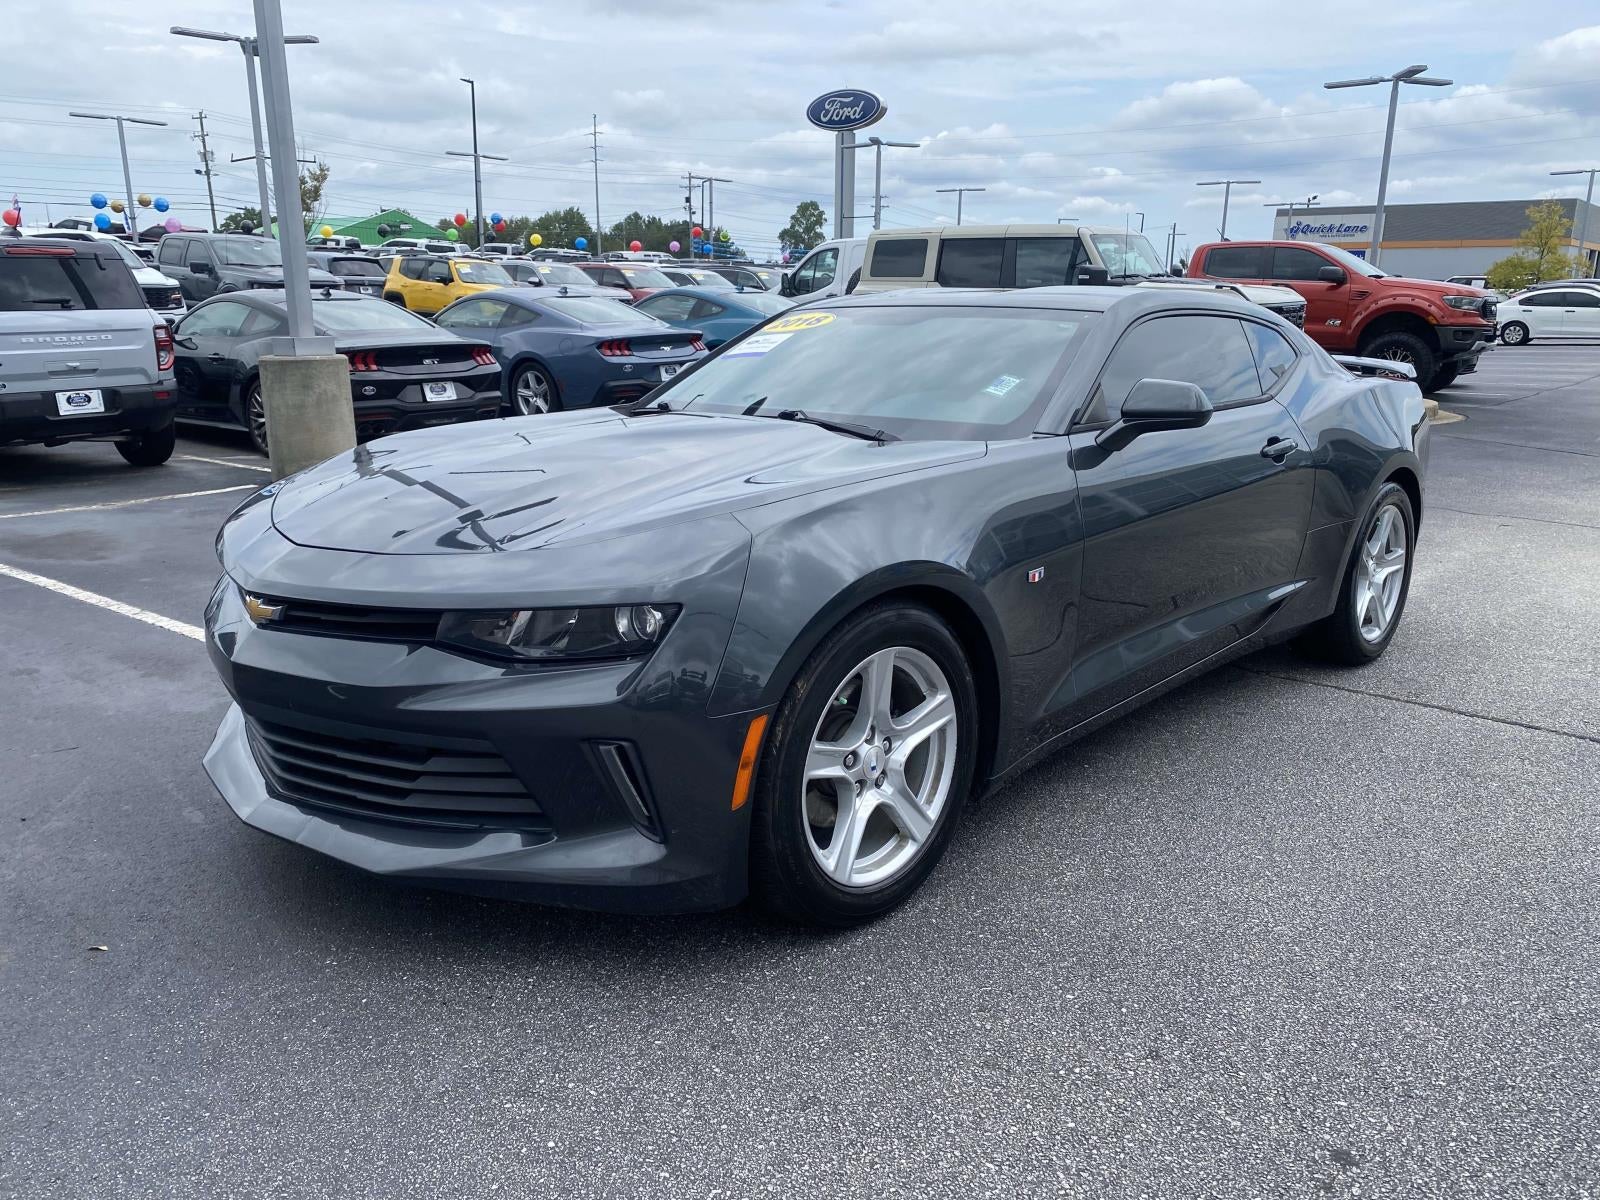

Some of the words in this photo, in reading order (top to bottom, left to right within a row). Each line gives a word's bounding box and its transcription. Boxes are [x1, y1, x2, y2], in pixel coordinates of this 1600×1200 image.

[820, 96, 865, 122] Ford
[1301, 223, 1335, 234] Quick
[1336, 223, 1368, 233] Lane
[21, 334, 113, 343] BRONCO
